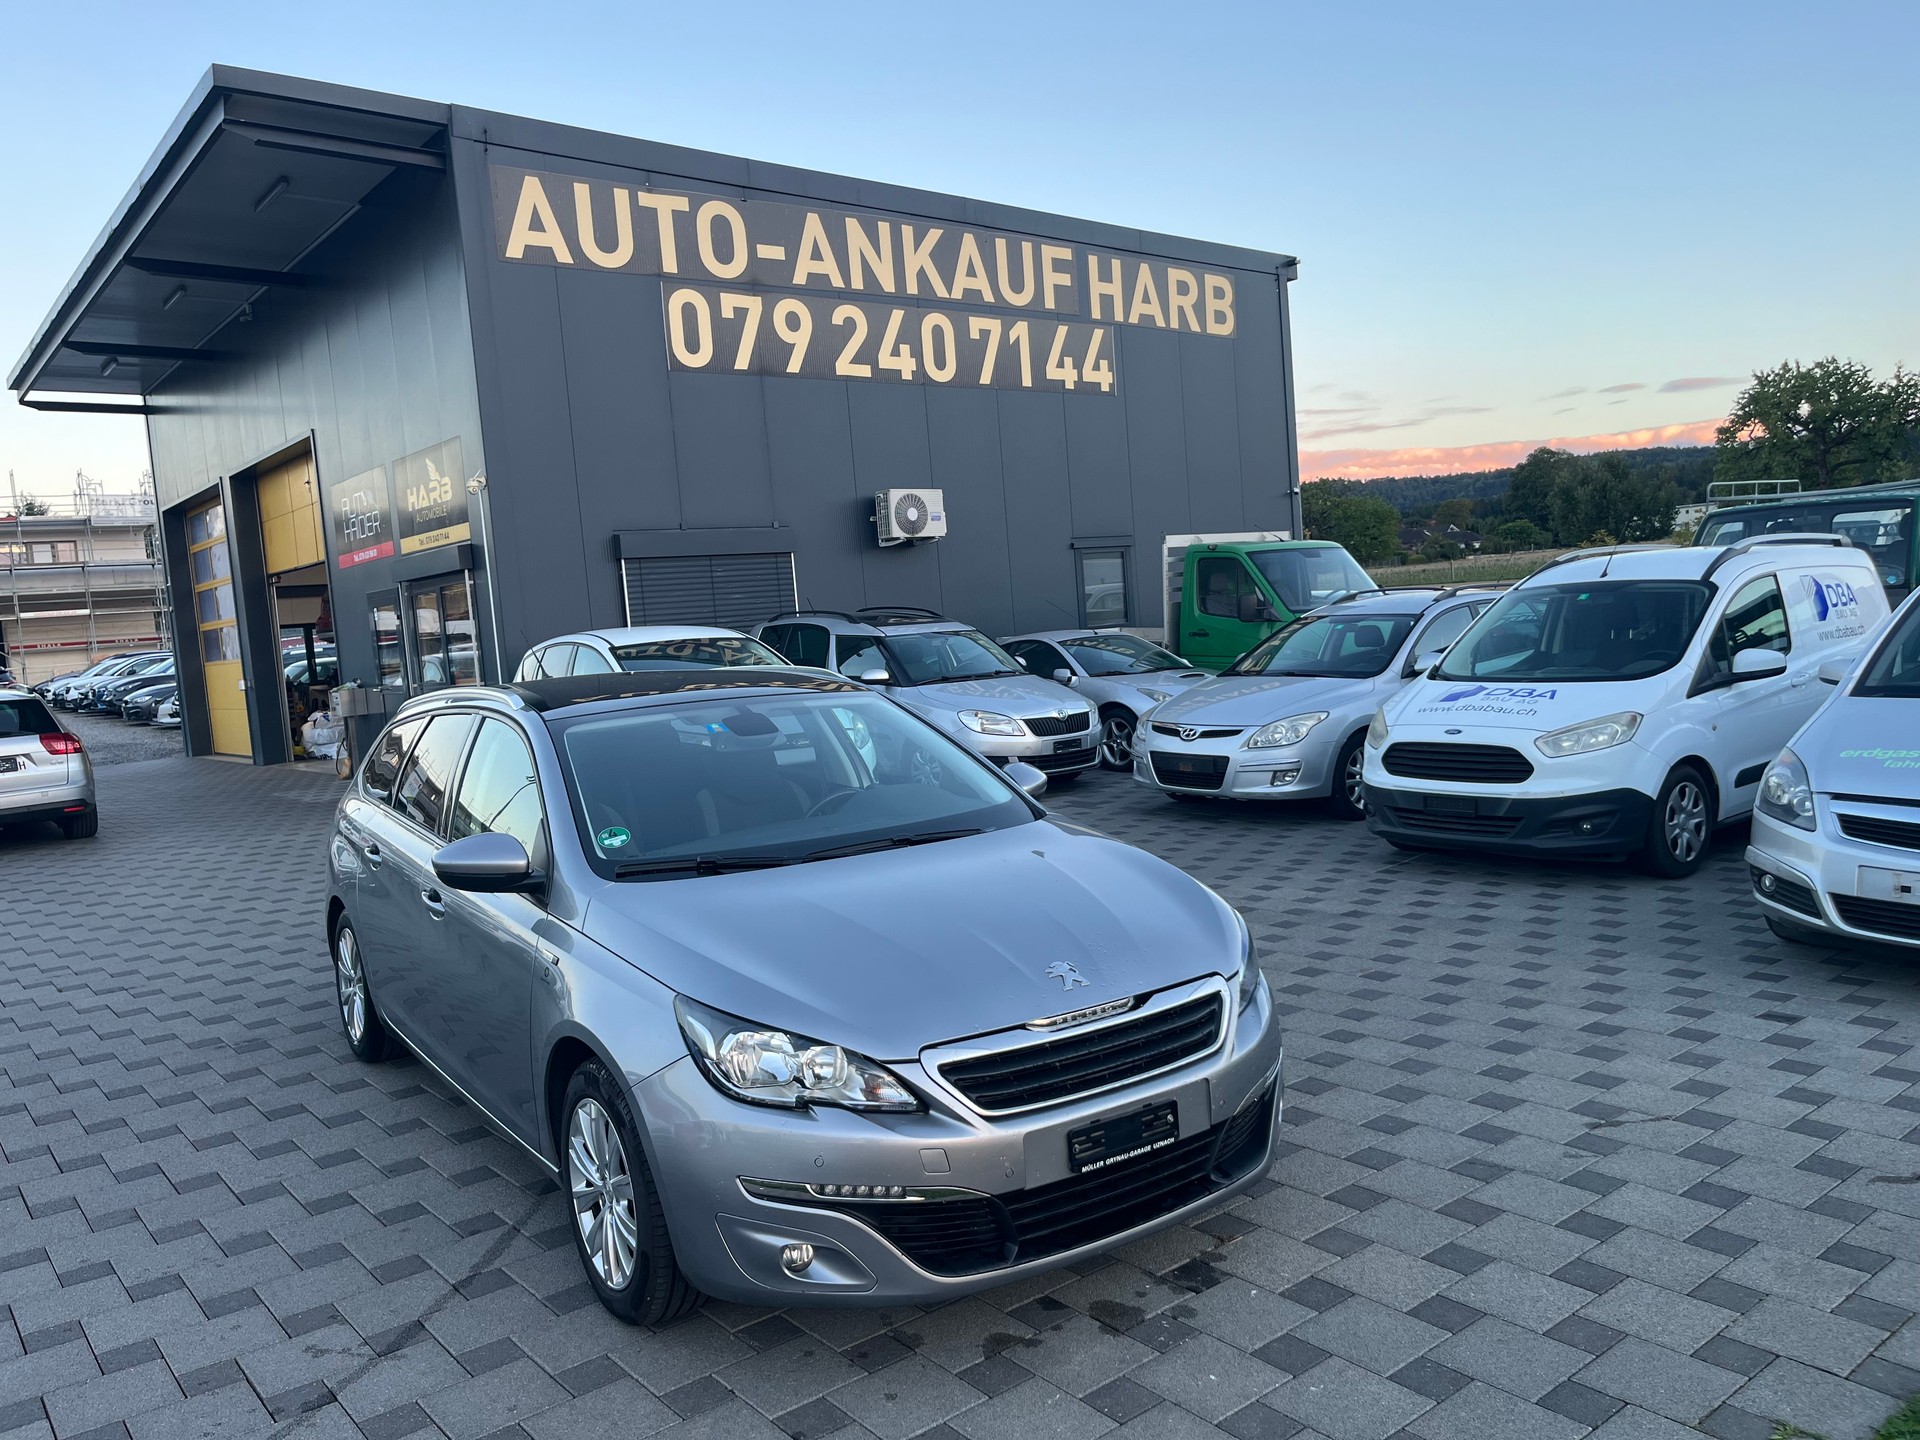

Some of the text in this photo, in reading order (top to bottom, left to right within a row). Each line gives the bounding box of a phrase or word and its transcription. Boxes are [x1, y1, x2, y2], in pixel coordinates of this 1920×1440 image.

[505, 175, 1235, 336] AUTO-ANKAUF HARB
[668, 288, 813, 373] 079
[831, 304, 957, 382] 240
[407, 476, 453, 511] HARB
[1825, 582, 1858, 608] DBA
[1817, 624, 1866, 641] www.dbabau.ch
[1484, 687, 1557, 700] DBA
[1417, 703, 1537, 717] www.dbabau.ch
[1081, 1160, 1104, 1173] MÜLLER
[1152, 1137, 1175, 1149] UZNACH
